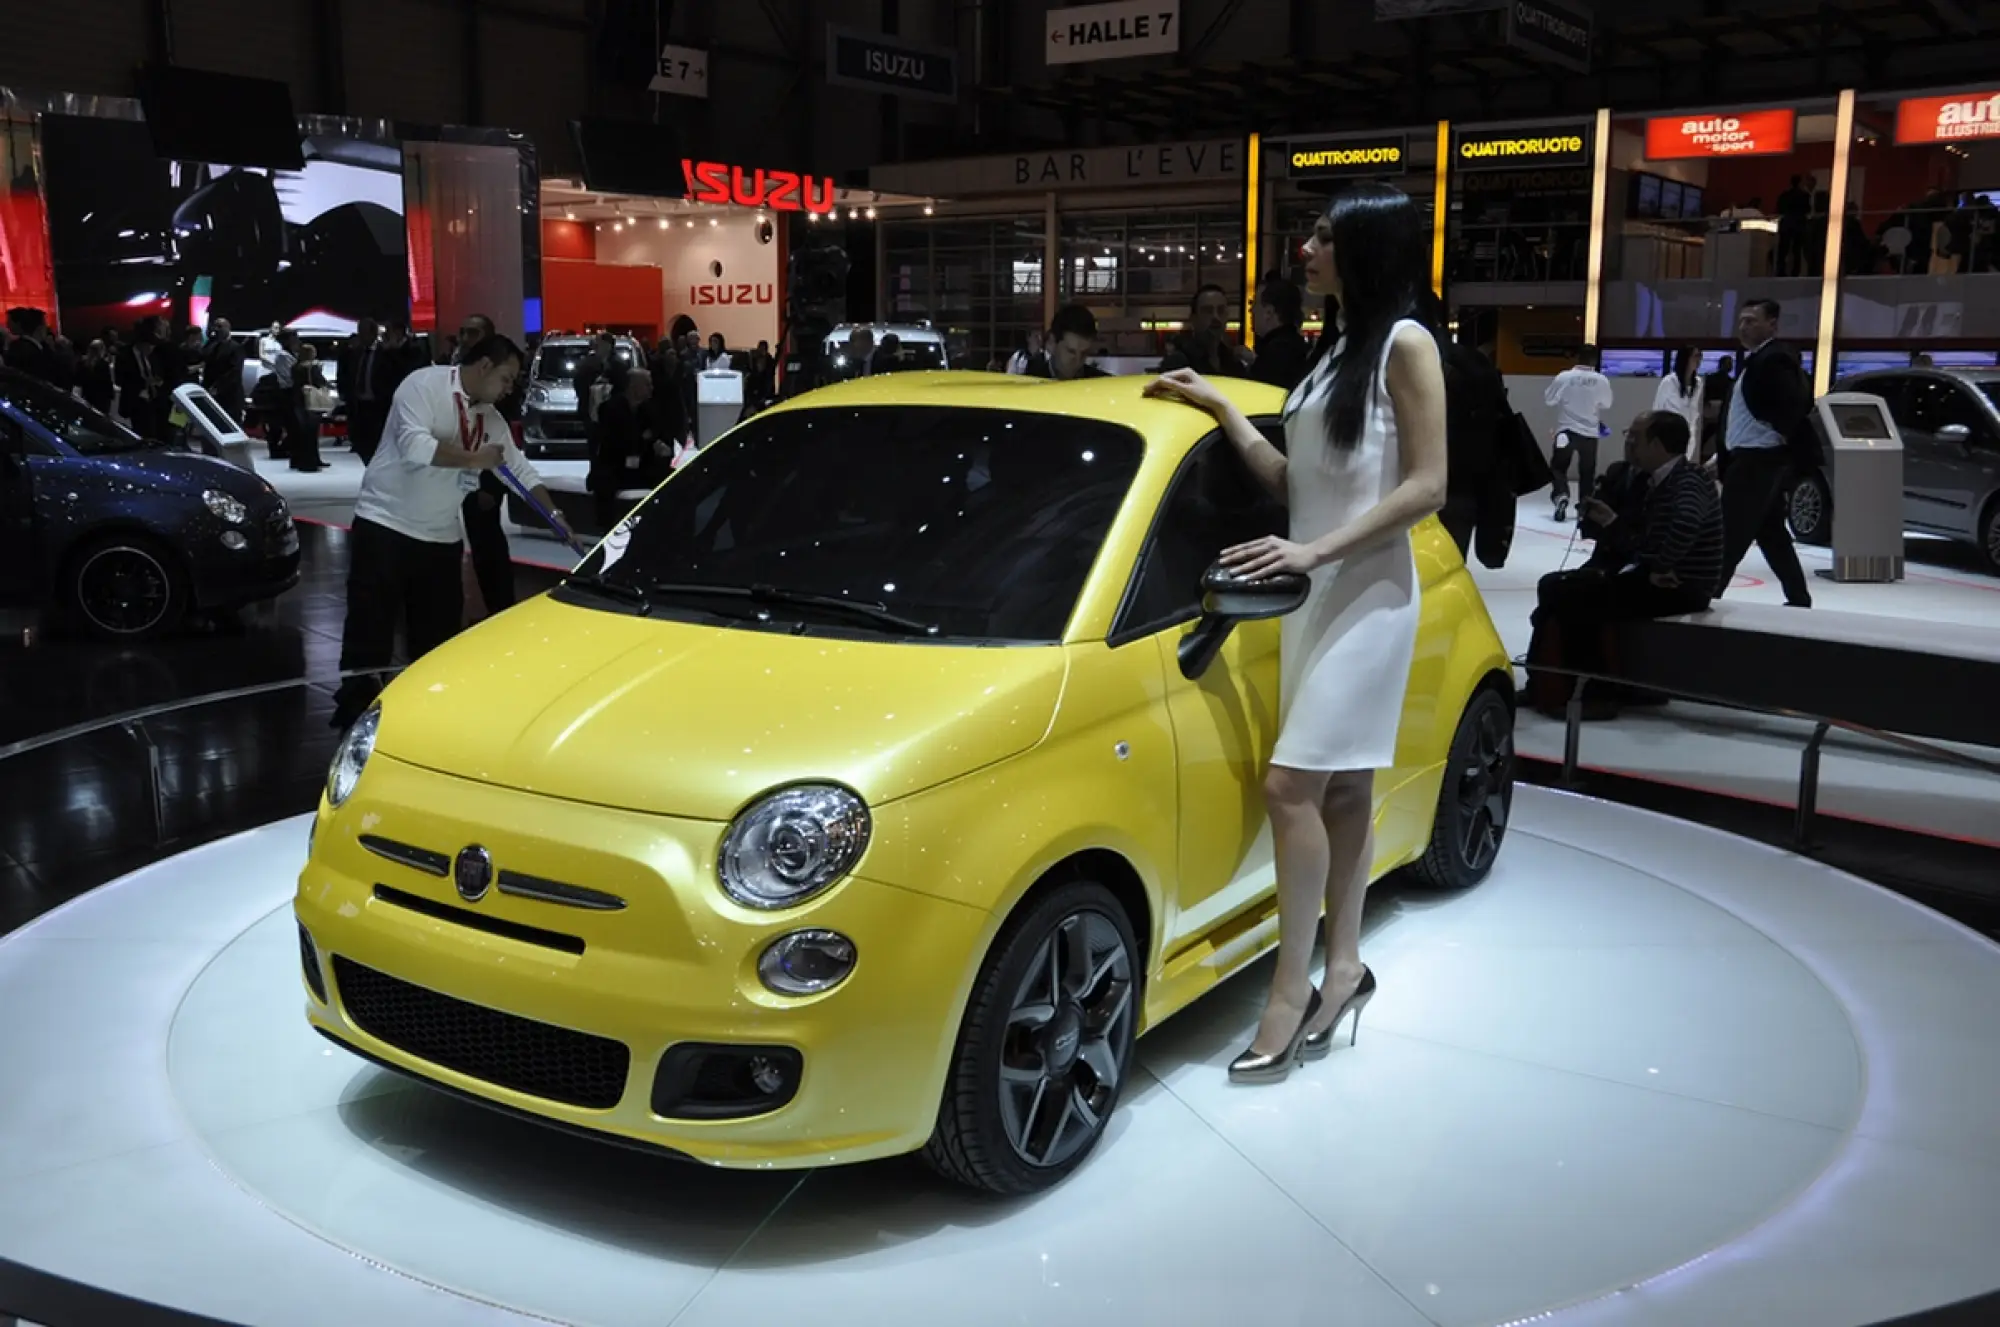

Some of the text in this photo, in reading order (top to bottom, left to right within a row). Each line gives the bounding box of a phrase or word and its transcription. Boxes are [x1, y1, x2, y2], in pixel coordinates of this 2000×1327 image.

[1069, 13, 1173, 46] HALLE 7
[678, 61, 690, 80] 7
[865, 49, 926, 81] ISUZU
[1681, 118, 1740, 135] auto
[1692, 131, 1750, 144] motor
[1712, 140, 1755, 153] sport
[1016, 153, 1086, 184] BAR
[681, 158, 834, 214] ISUZU
[690, 284, 773, 306] ISUZU
